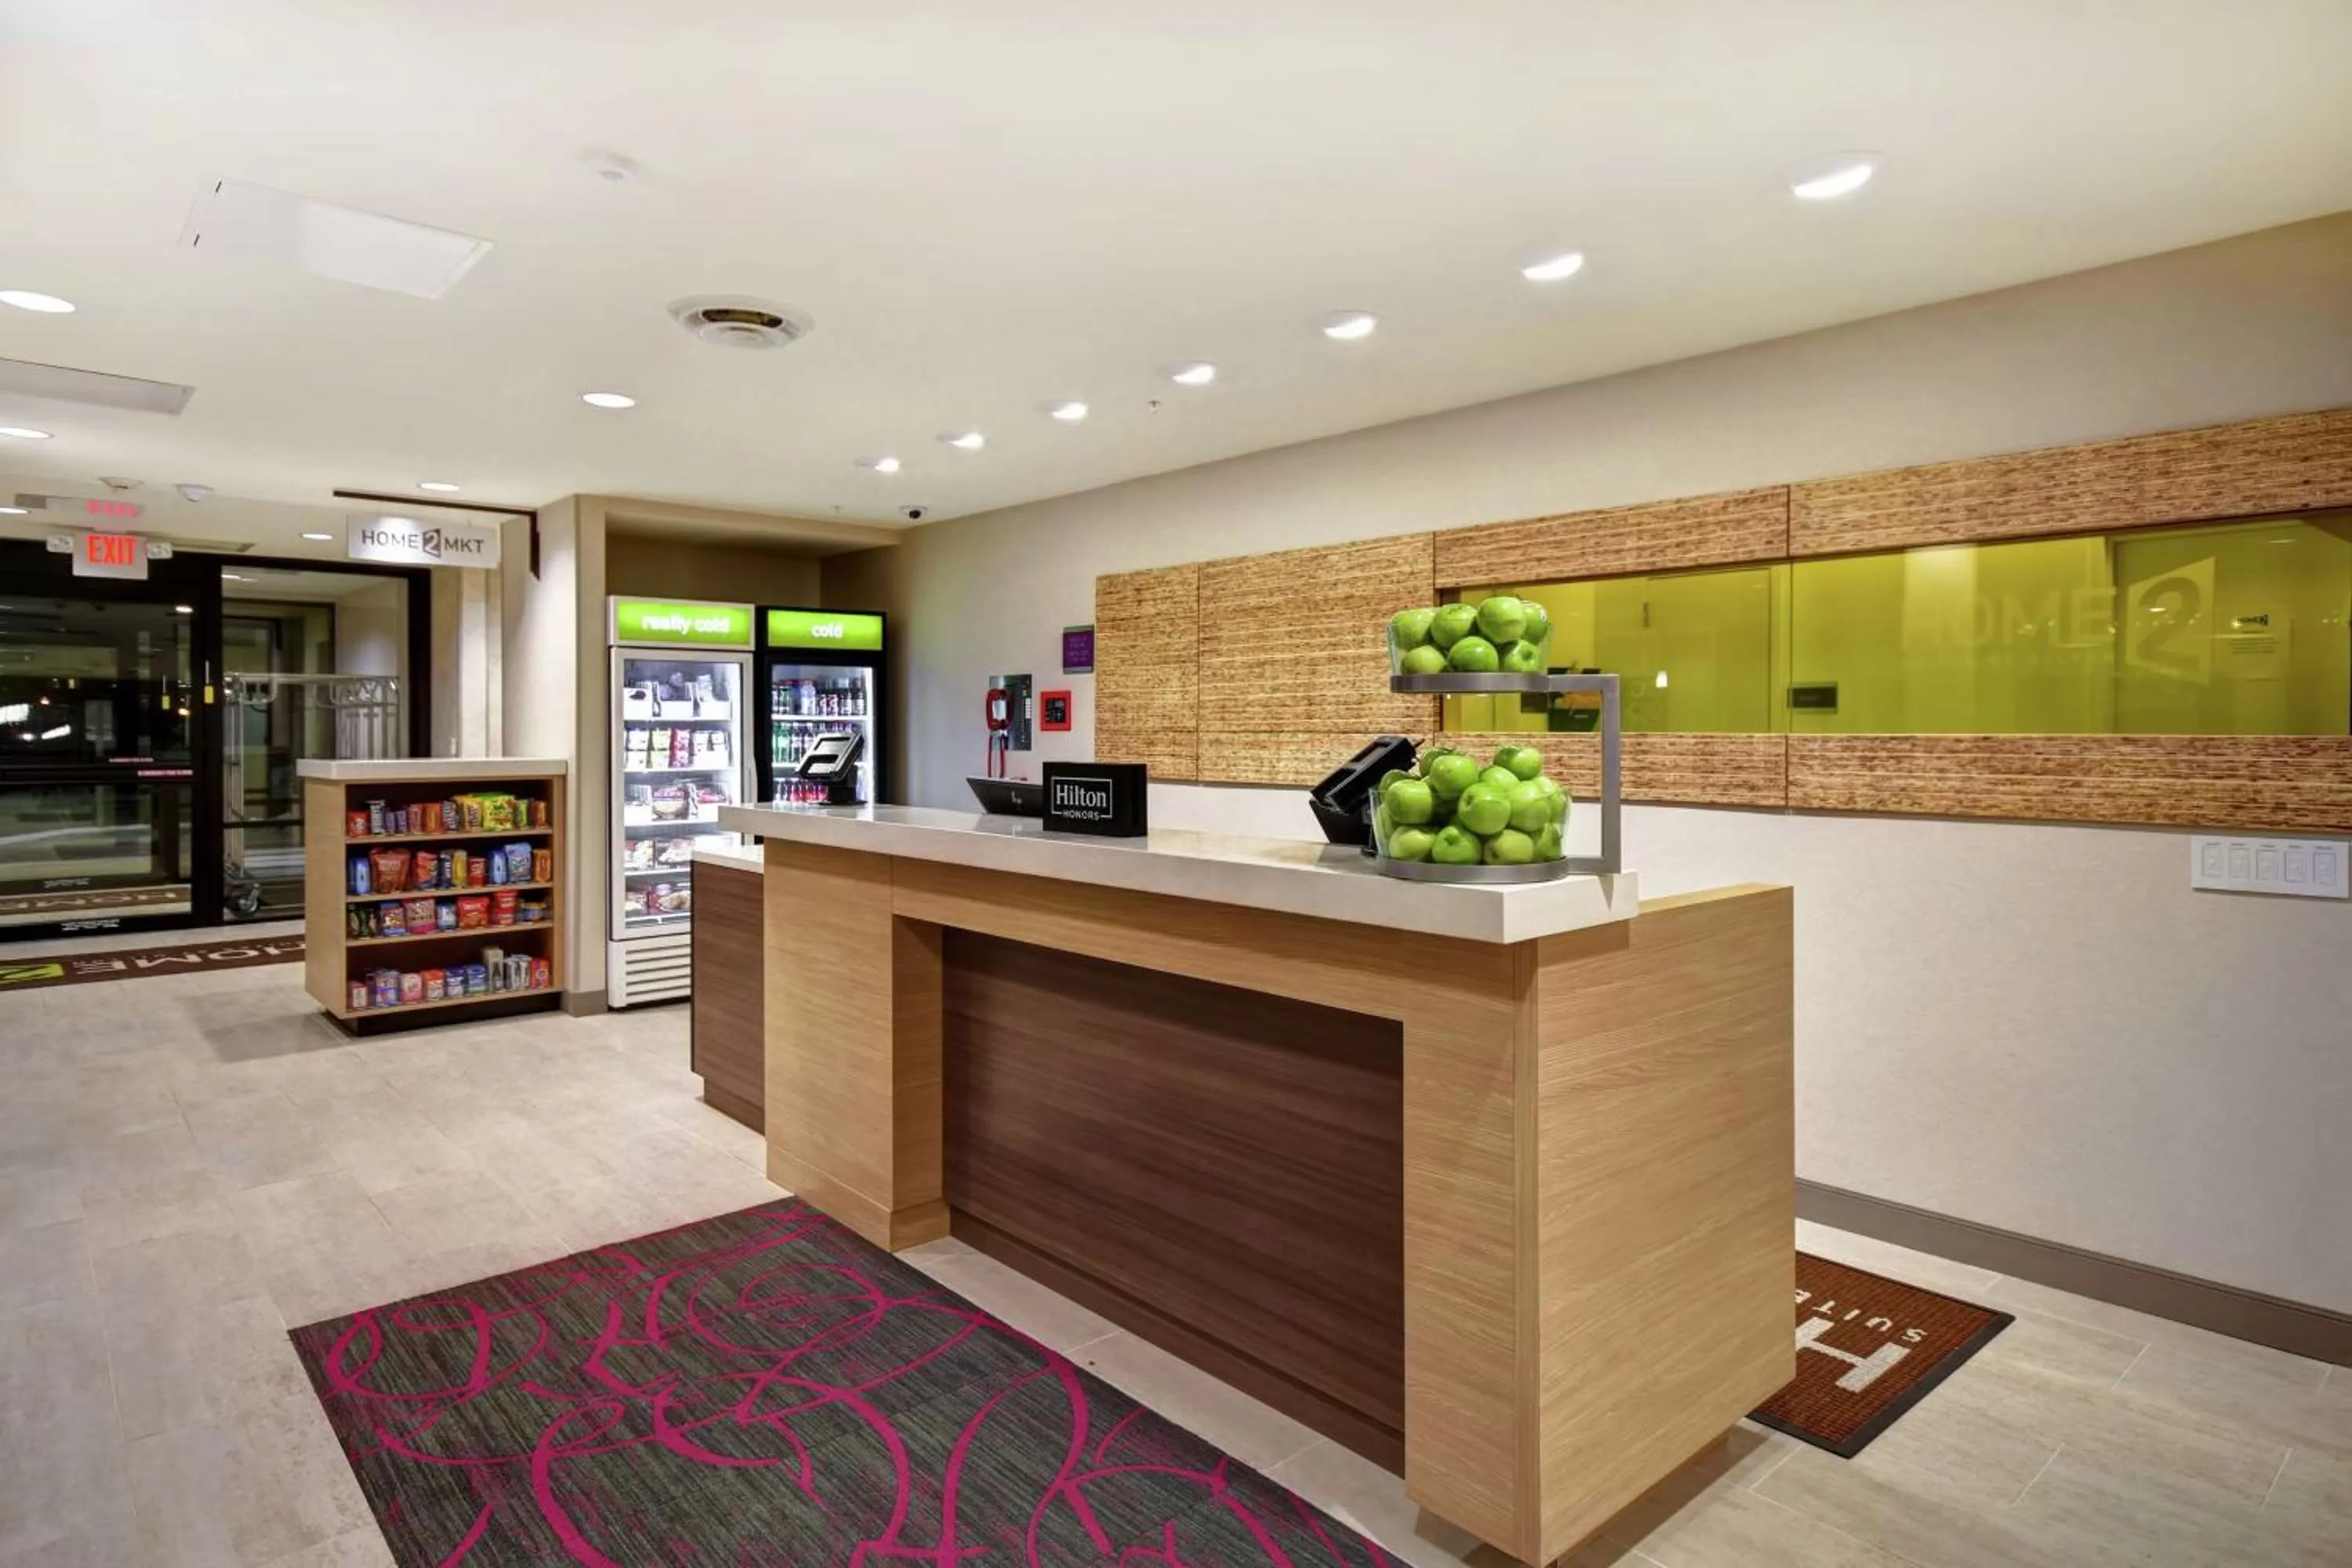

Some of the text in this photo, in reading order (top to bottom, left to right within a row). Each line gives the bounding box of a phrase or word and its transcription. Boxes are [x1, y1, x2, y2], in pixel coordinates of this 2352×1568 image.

[87, 535, 136, 565] EXIT
[641, 612, 731, 635] really cold
[811, 621, 844, 638] cold
[1055, 784, 1107, 808] Hilton
[1062, 809, 1100, 821] HONORS
